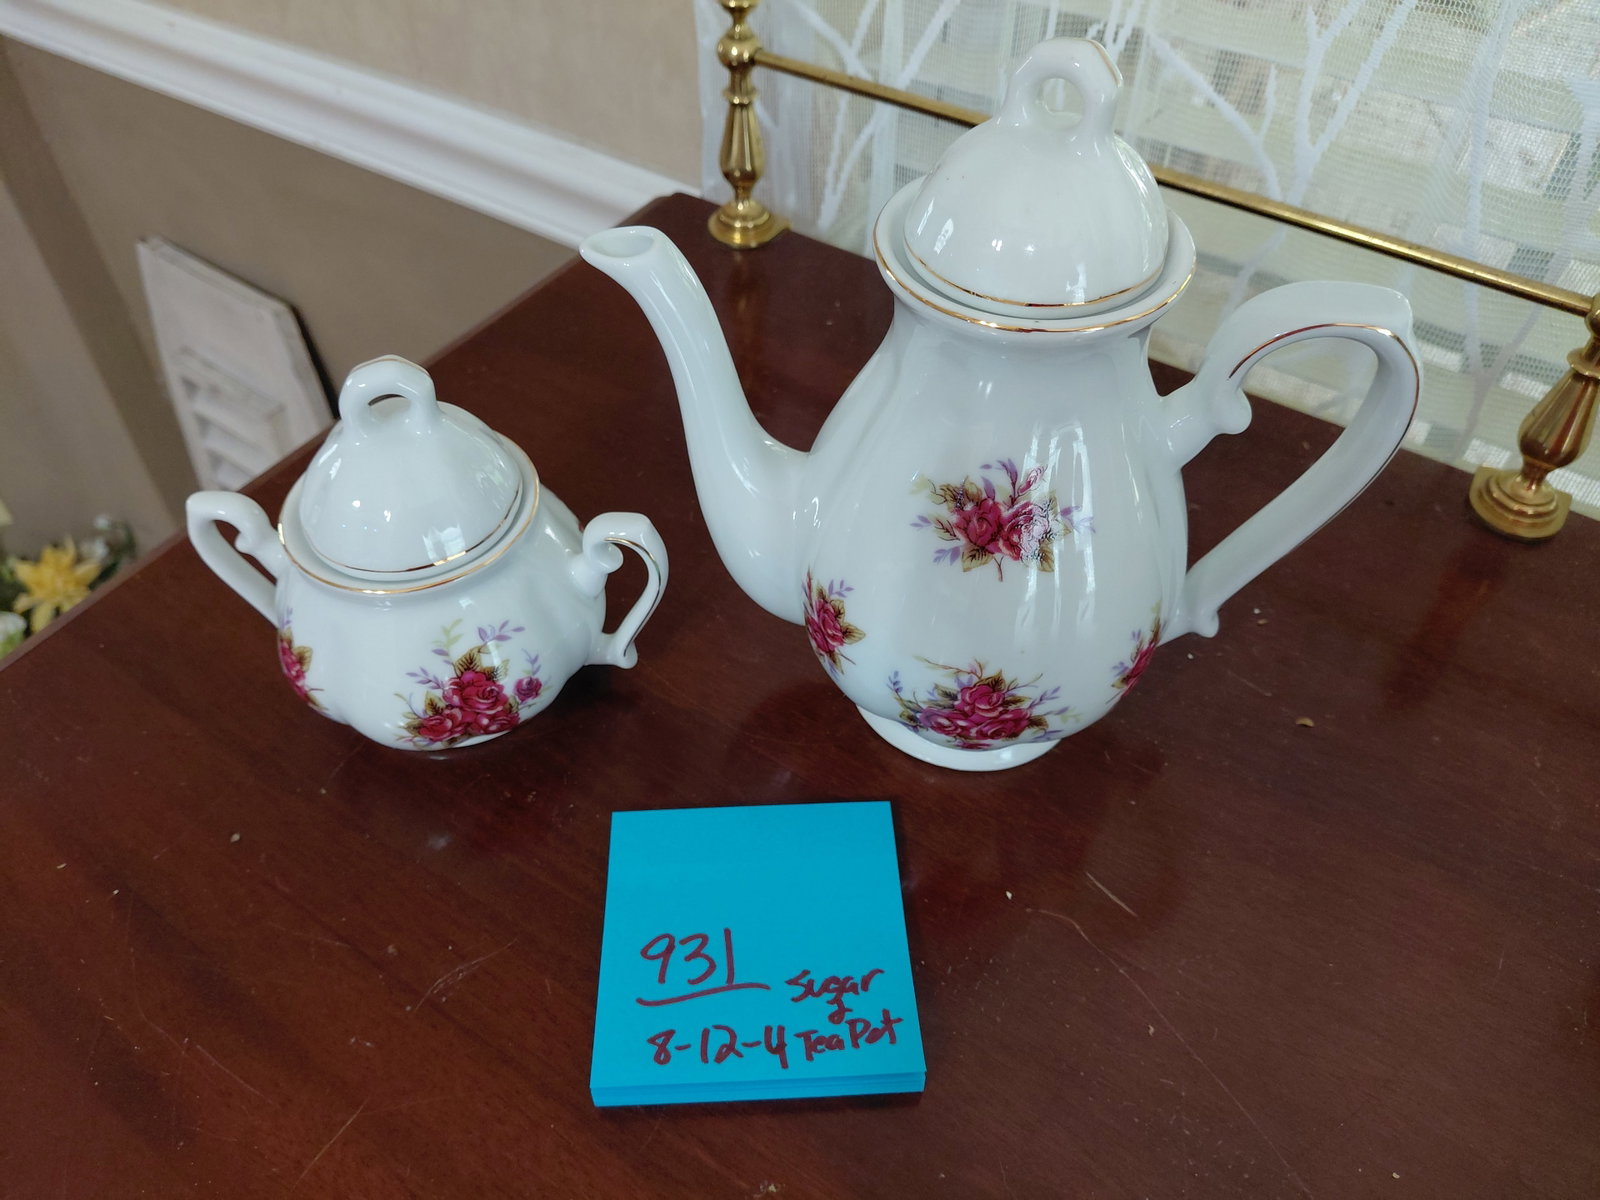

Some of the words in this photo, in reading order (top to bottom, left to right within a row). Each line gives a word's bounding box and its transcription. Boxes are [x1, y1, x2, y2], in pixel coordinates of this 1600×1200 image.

[640, 927, 735, 986] 931
[785, 968, 885, 1005] Sugar
[647, 1025, 788, 1069] 8-12-4
